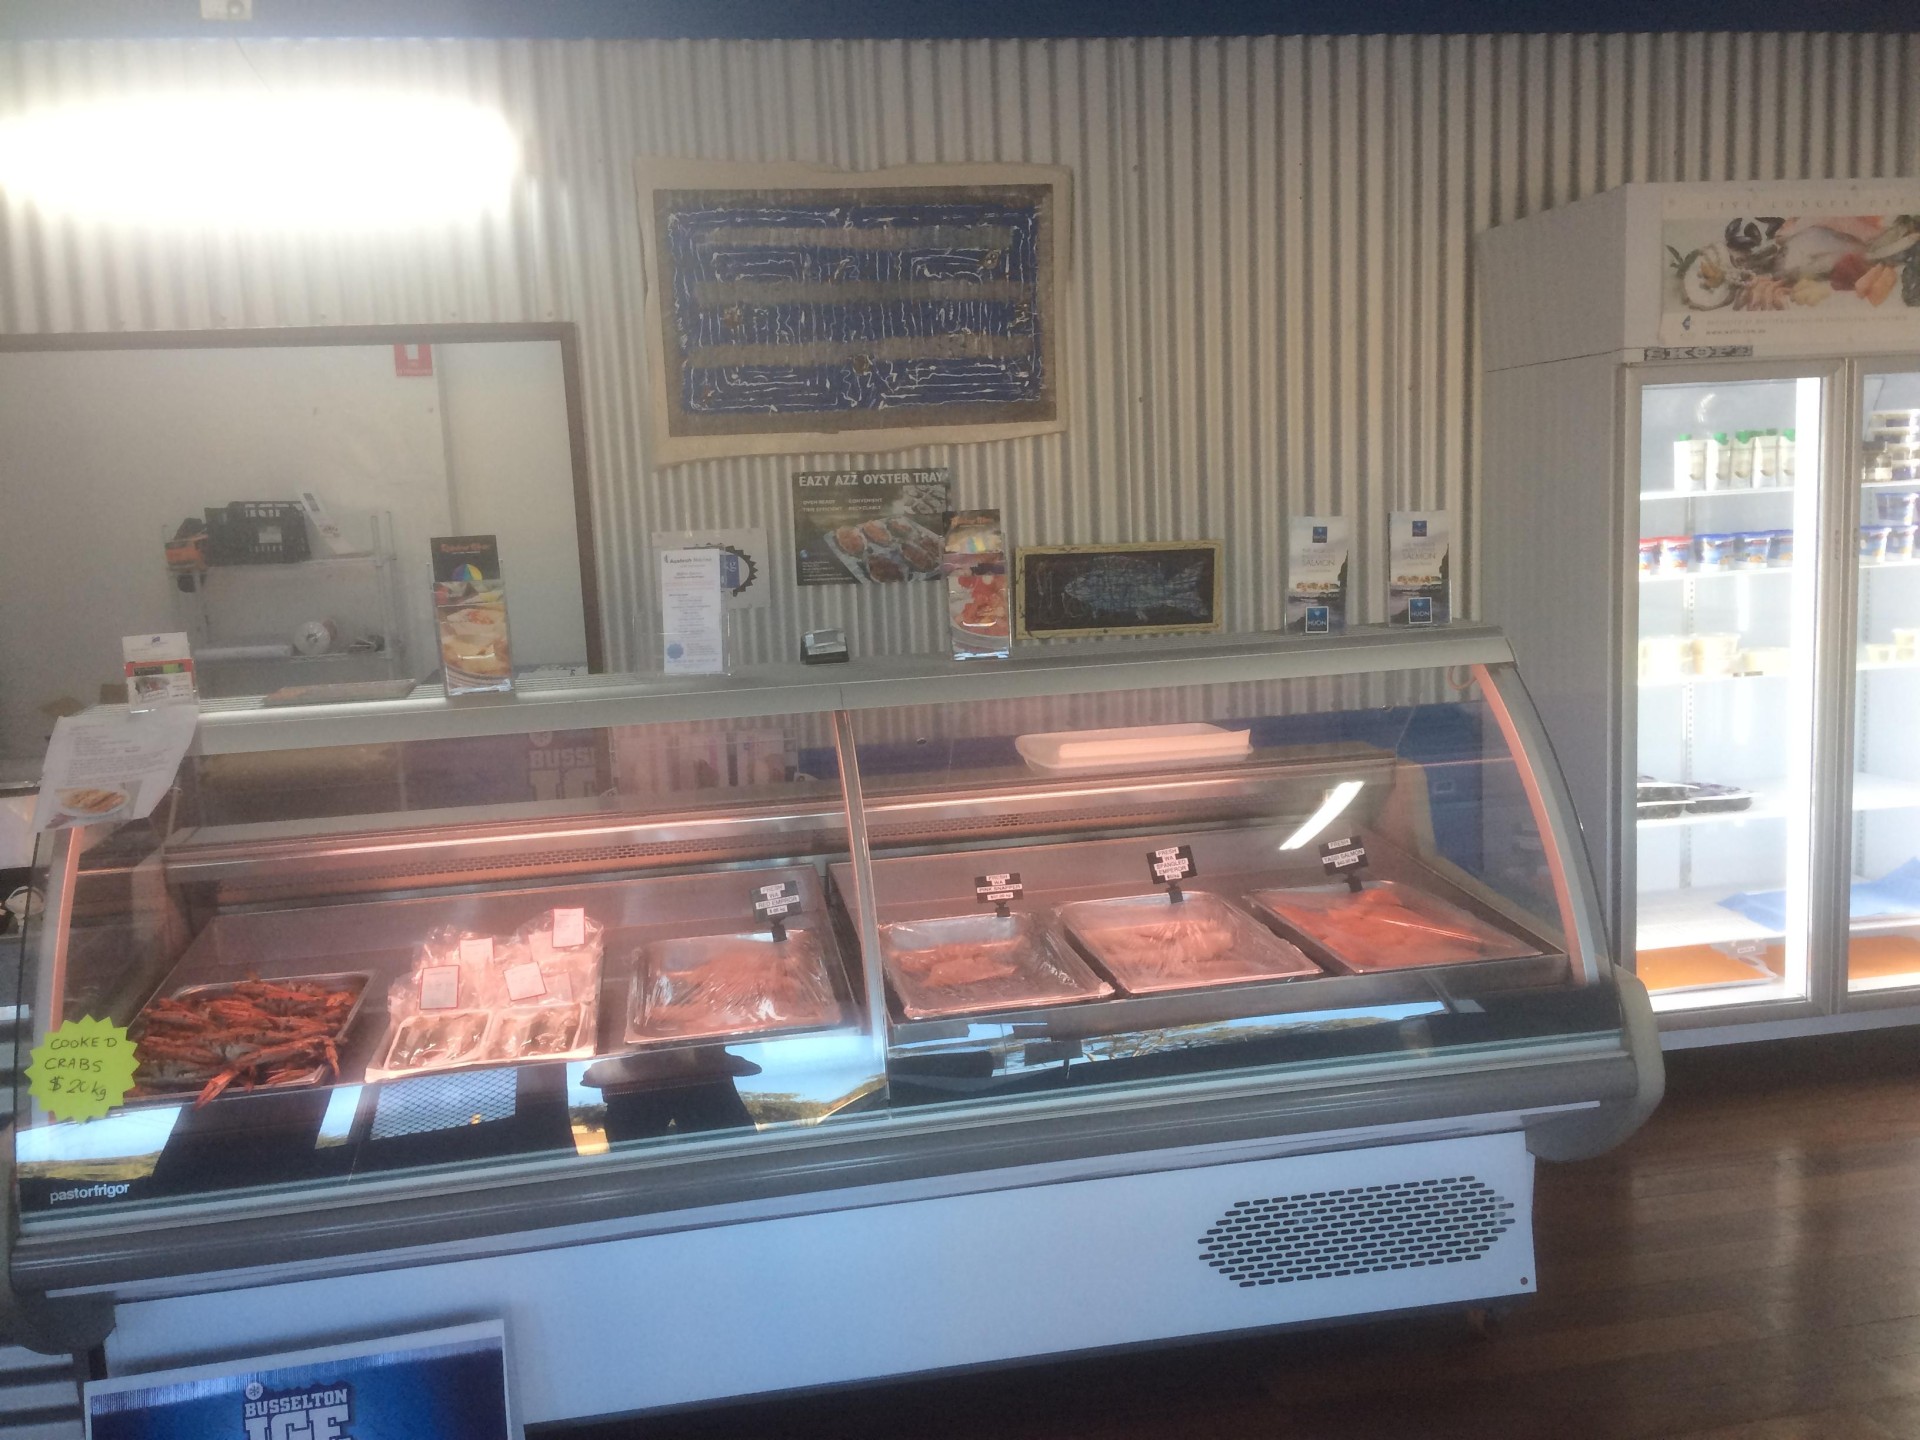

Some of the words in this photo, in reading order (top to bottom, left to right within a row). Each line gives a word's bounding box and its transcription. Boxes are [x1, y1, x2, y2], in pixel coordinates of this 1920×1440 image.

[800, 476, 830, 487] EAZY
[863, 474, 910, 484] OYSTER
[913, 472, 943, 483] TRAY
[1402, 552, 1436, 560] SALMON
[1302, 559, 1335, 567] SALMON
[1156, 859, 1186, 869] SPANGLED
[1158, 865, 1186, 874] EMPEROR
[51, 1038, 117, 1049] COOKED
[45, 1058, 102, 1073] CRABS
[50, 1183, 130, 1205] pastorfrigor
[245, 1388, 347, 1418] BUSSELTON
